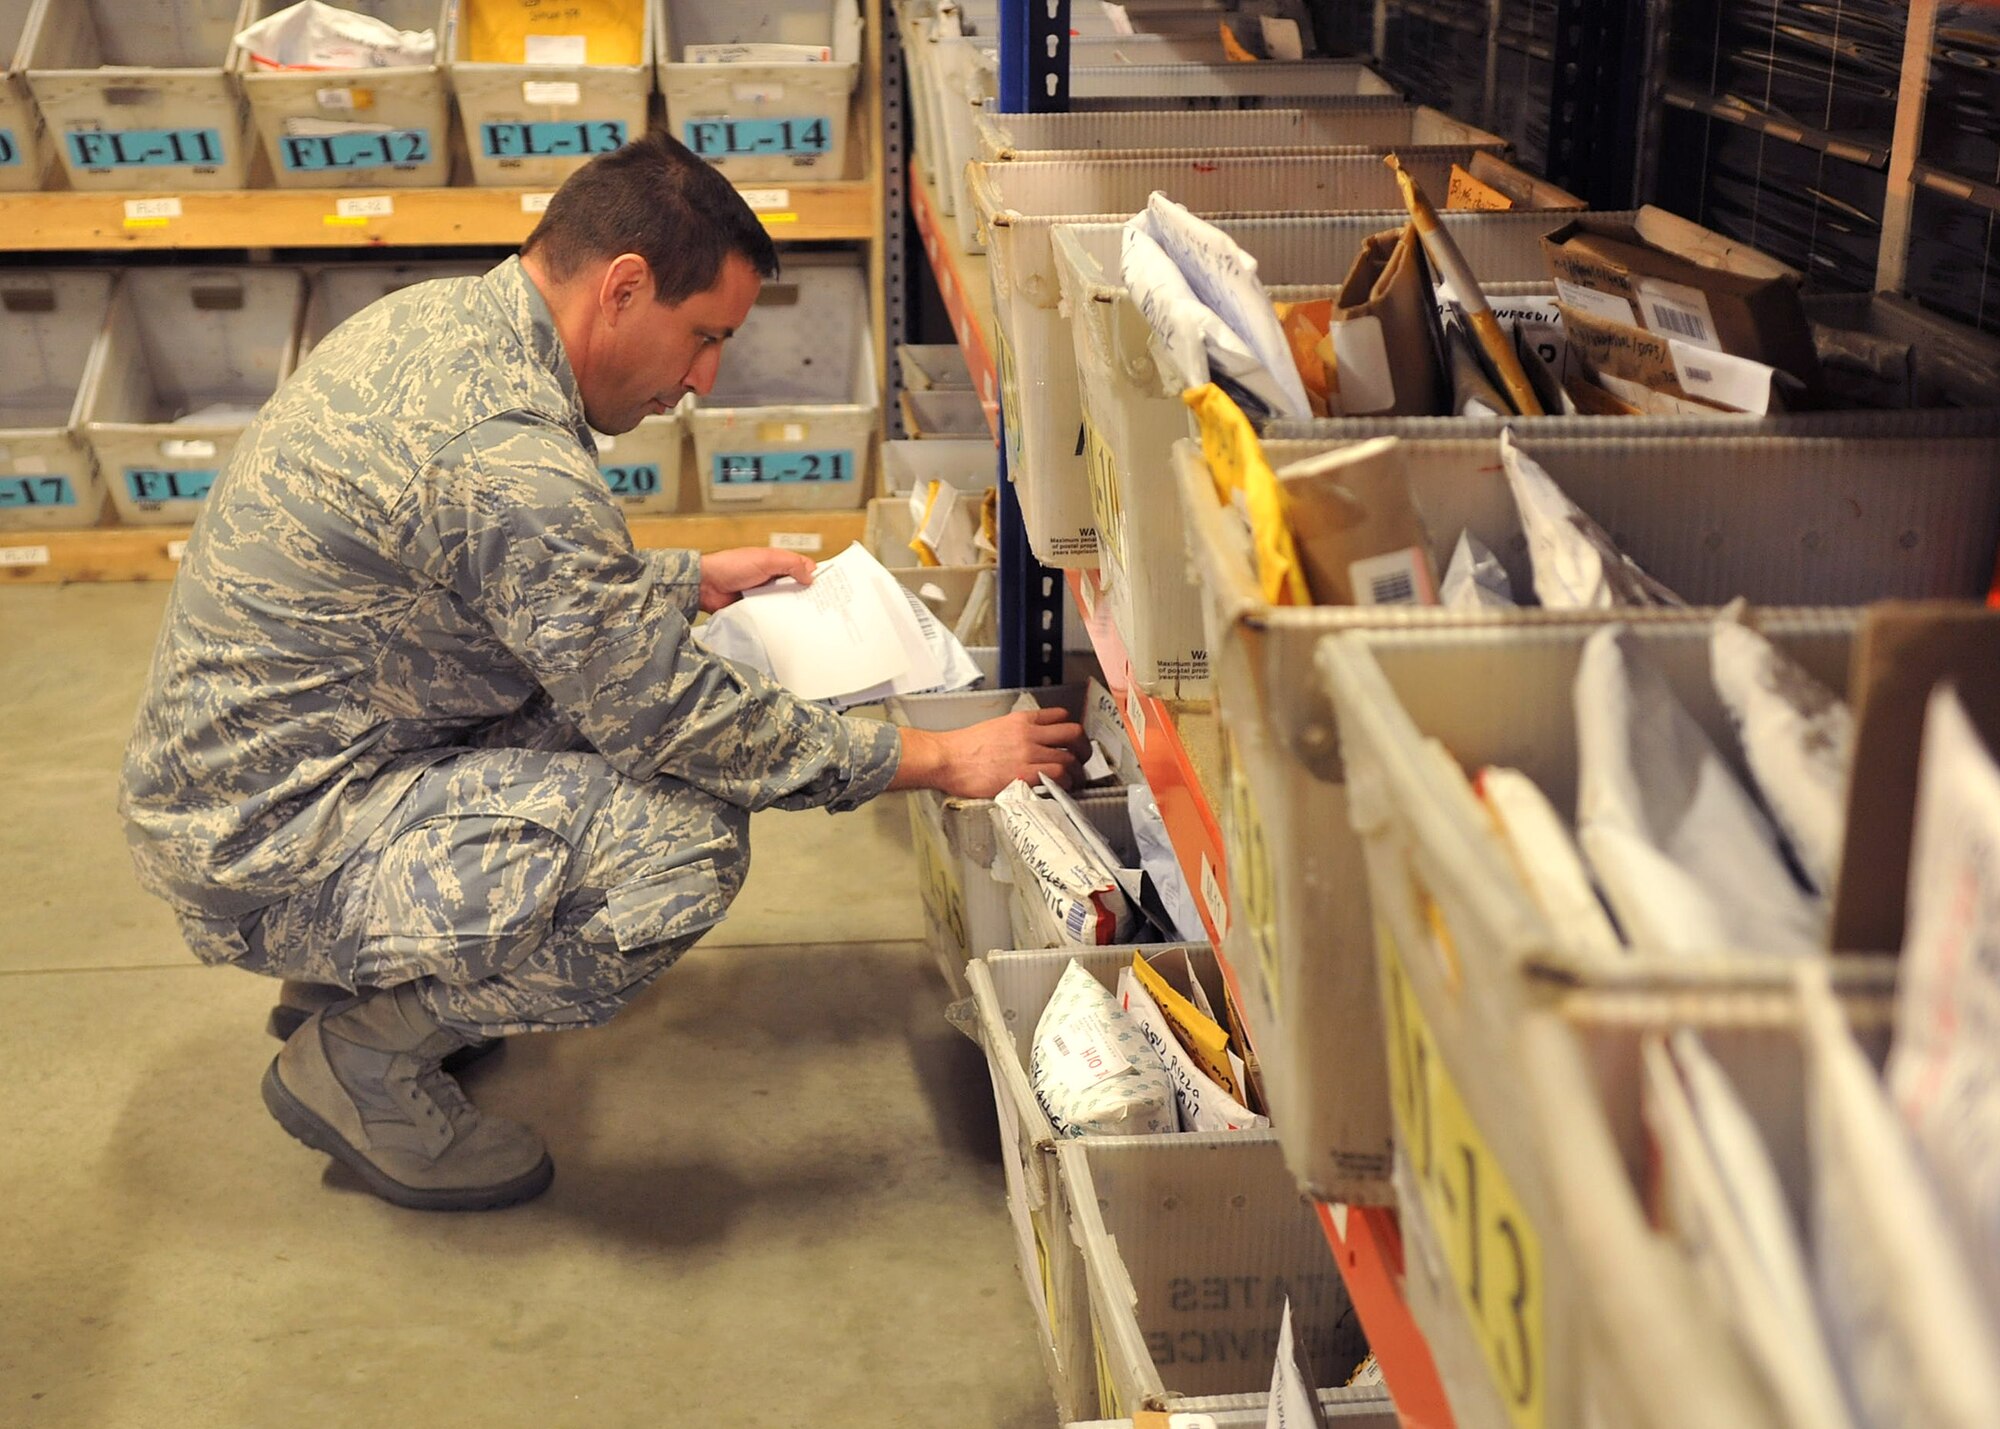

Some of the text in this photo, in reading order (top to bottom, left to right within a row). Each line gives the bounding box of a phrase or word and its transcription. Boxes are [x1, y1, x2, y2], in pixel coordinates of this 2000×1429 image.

[74, 131, 214, 164] FL-11
[286, 132, 426, 168] FL-12
[486, 122, 623, 154] FL-13
[690, 119, 826, 153] FL-14
[605, 466, 657, 494] 20
[719, 454, 844, 483] FL-21
